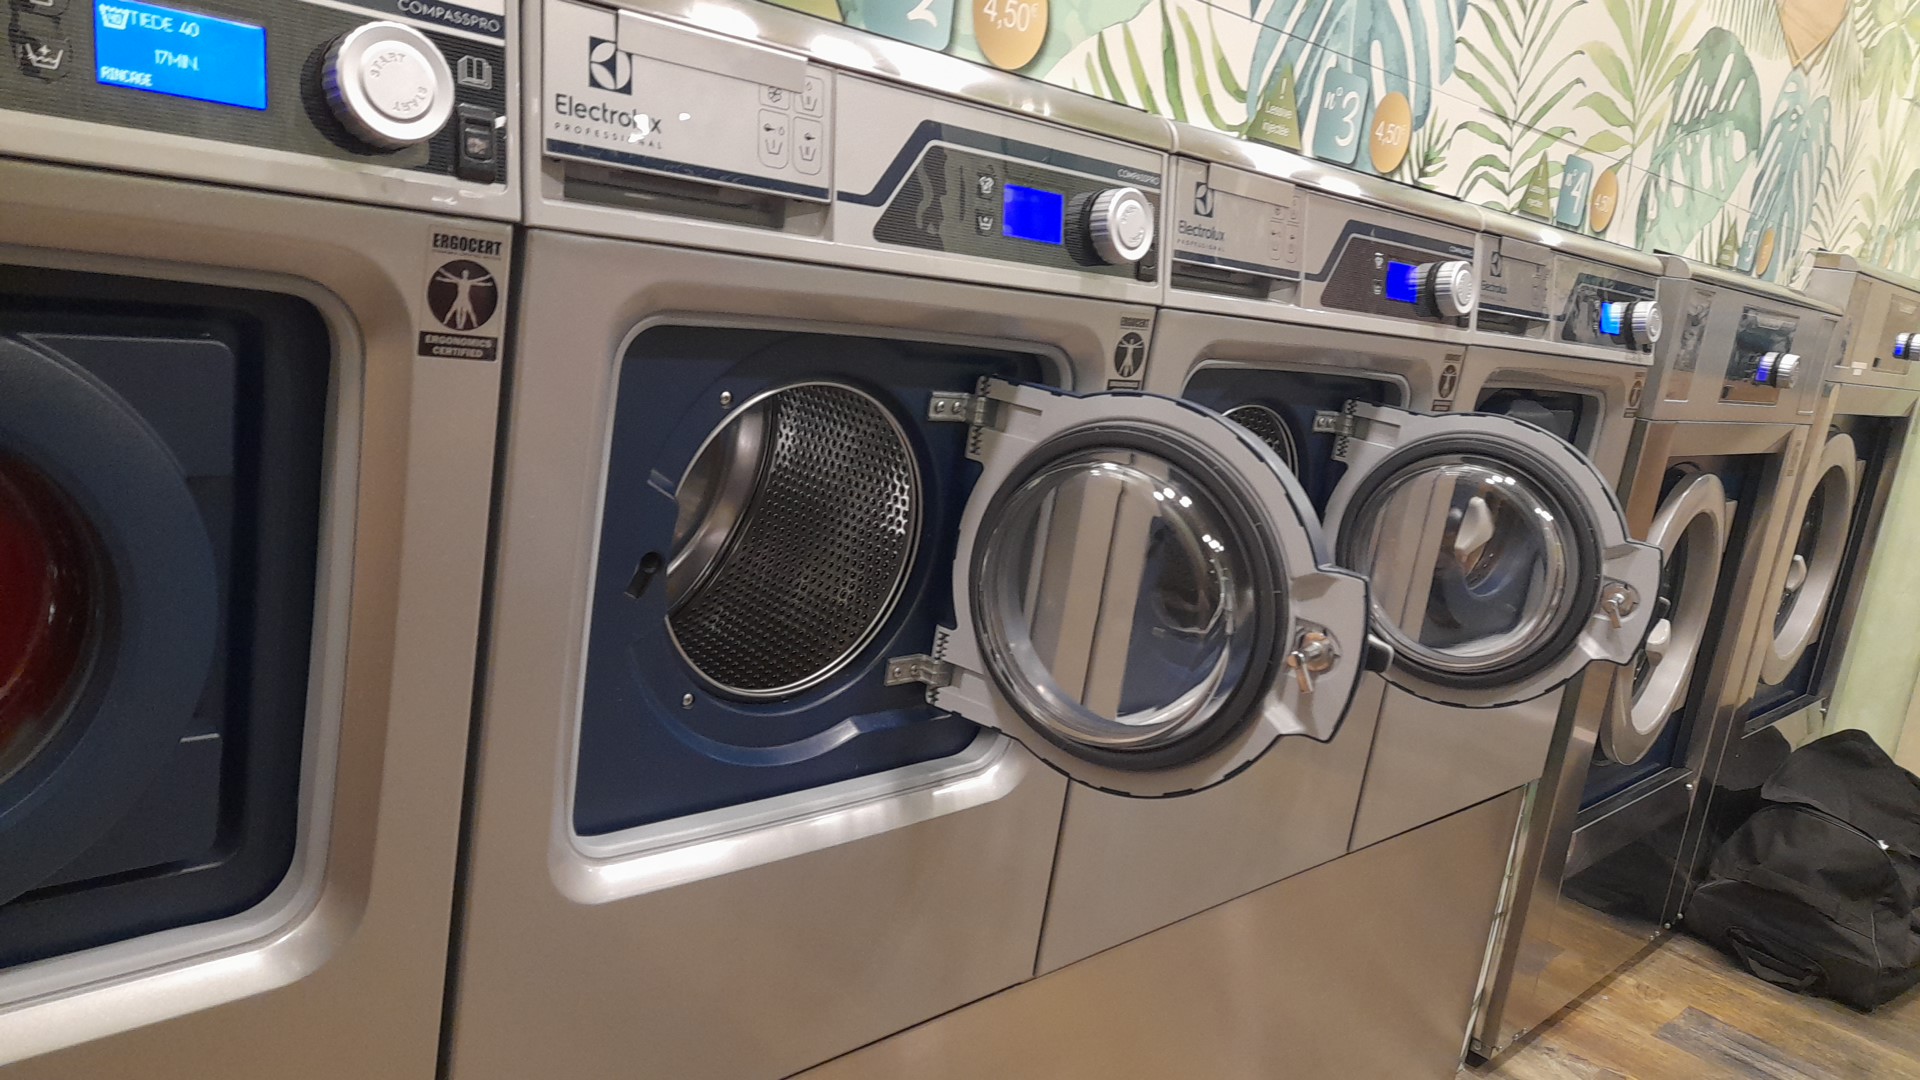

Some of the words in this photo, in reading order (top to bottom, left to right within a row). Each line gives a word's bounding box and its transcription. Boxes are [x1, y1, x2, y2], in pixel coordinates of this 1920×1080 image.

[130, 10, 174, 32] TIEDE
[178, 21, 200, 37] 40
[397, 0, 500, 32] COMPASSPRO
[100, 66, 153, 87] RINCAGE
[555, 93, 662, 134] Electrolx
[555, 122, 662, 150] PROFESSINAL
[1177, 220, 1225, 241] Electrolux
[433, 233, 502, 256] ERGOCERT
[425, 334, 492, 348] ERGONOMICS
[432, 346, 483, 358] CERTIFIED
